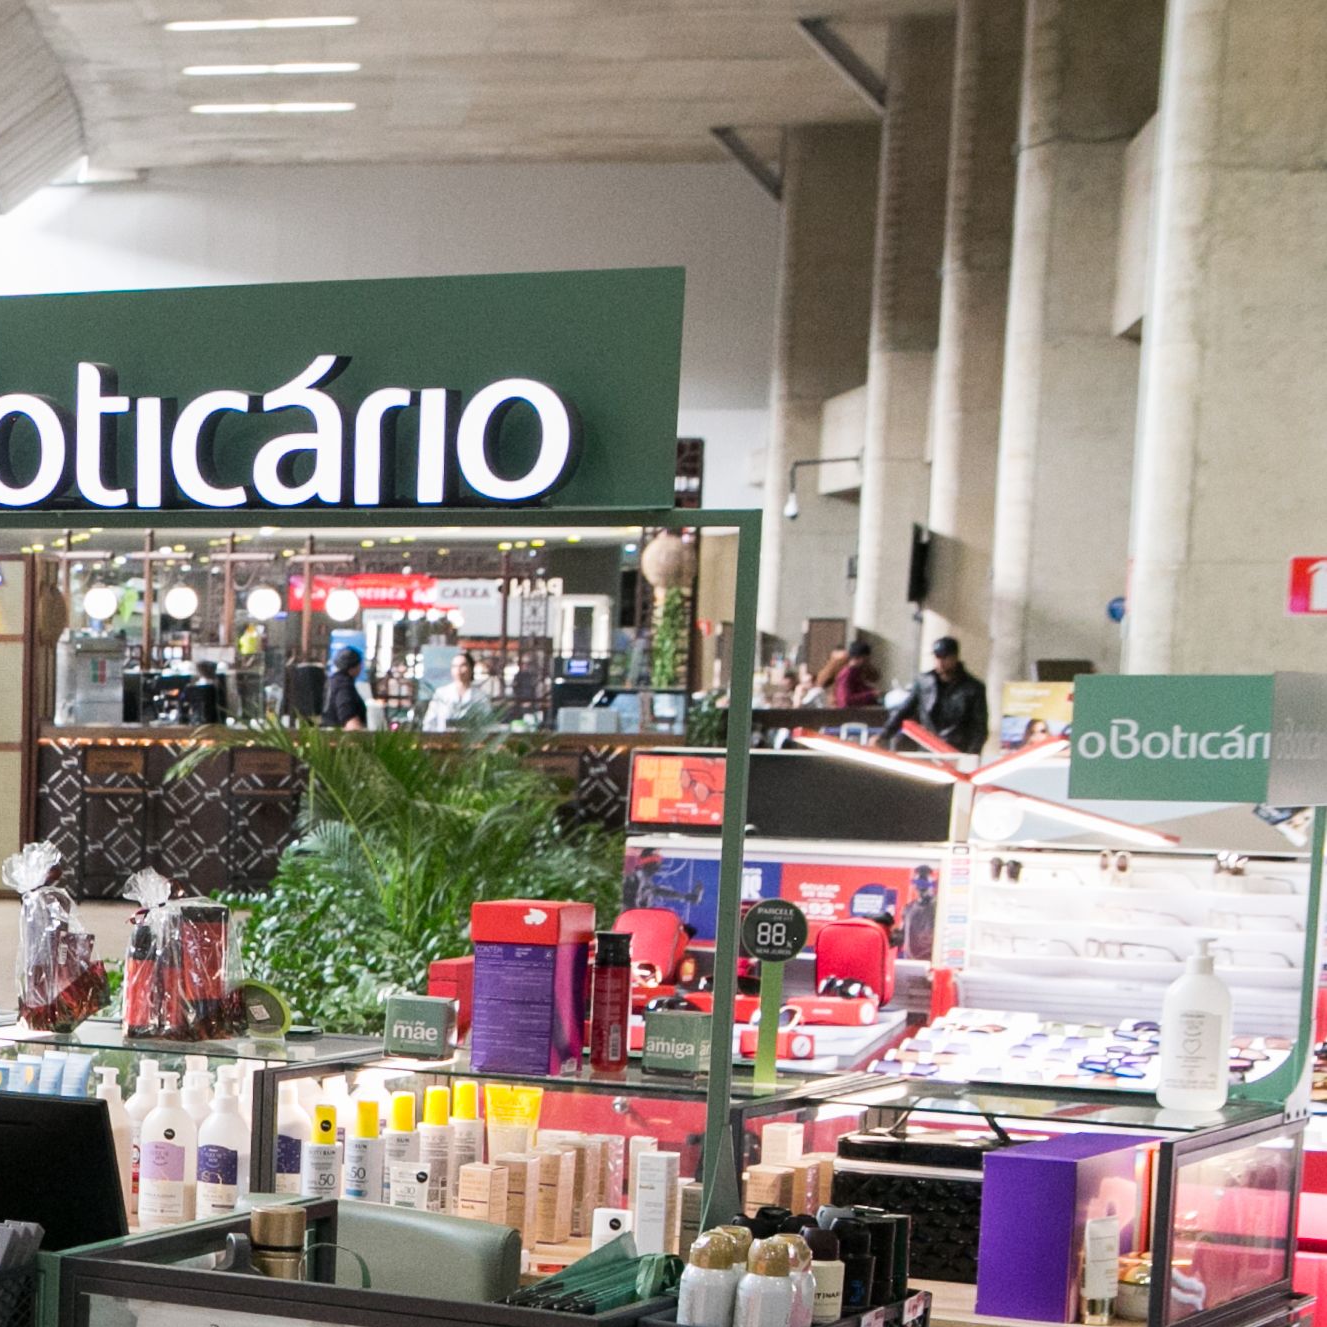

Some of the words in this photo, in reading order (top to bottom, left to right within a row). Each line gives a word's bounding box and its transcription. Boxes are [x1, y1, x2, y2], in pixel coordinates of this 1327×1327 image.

[1077, 718, 1271, 760] oBoticári
[392, 1021, 438, 1041] mãe
[646, 1038, 694, 1058] amiga
[318, 1174, 335, 1187] 50
[350, 1166, 366, 1180] 50
